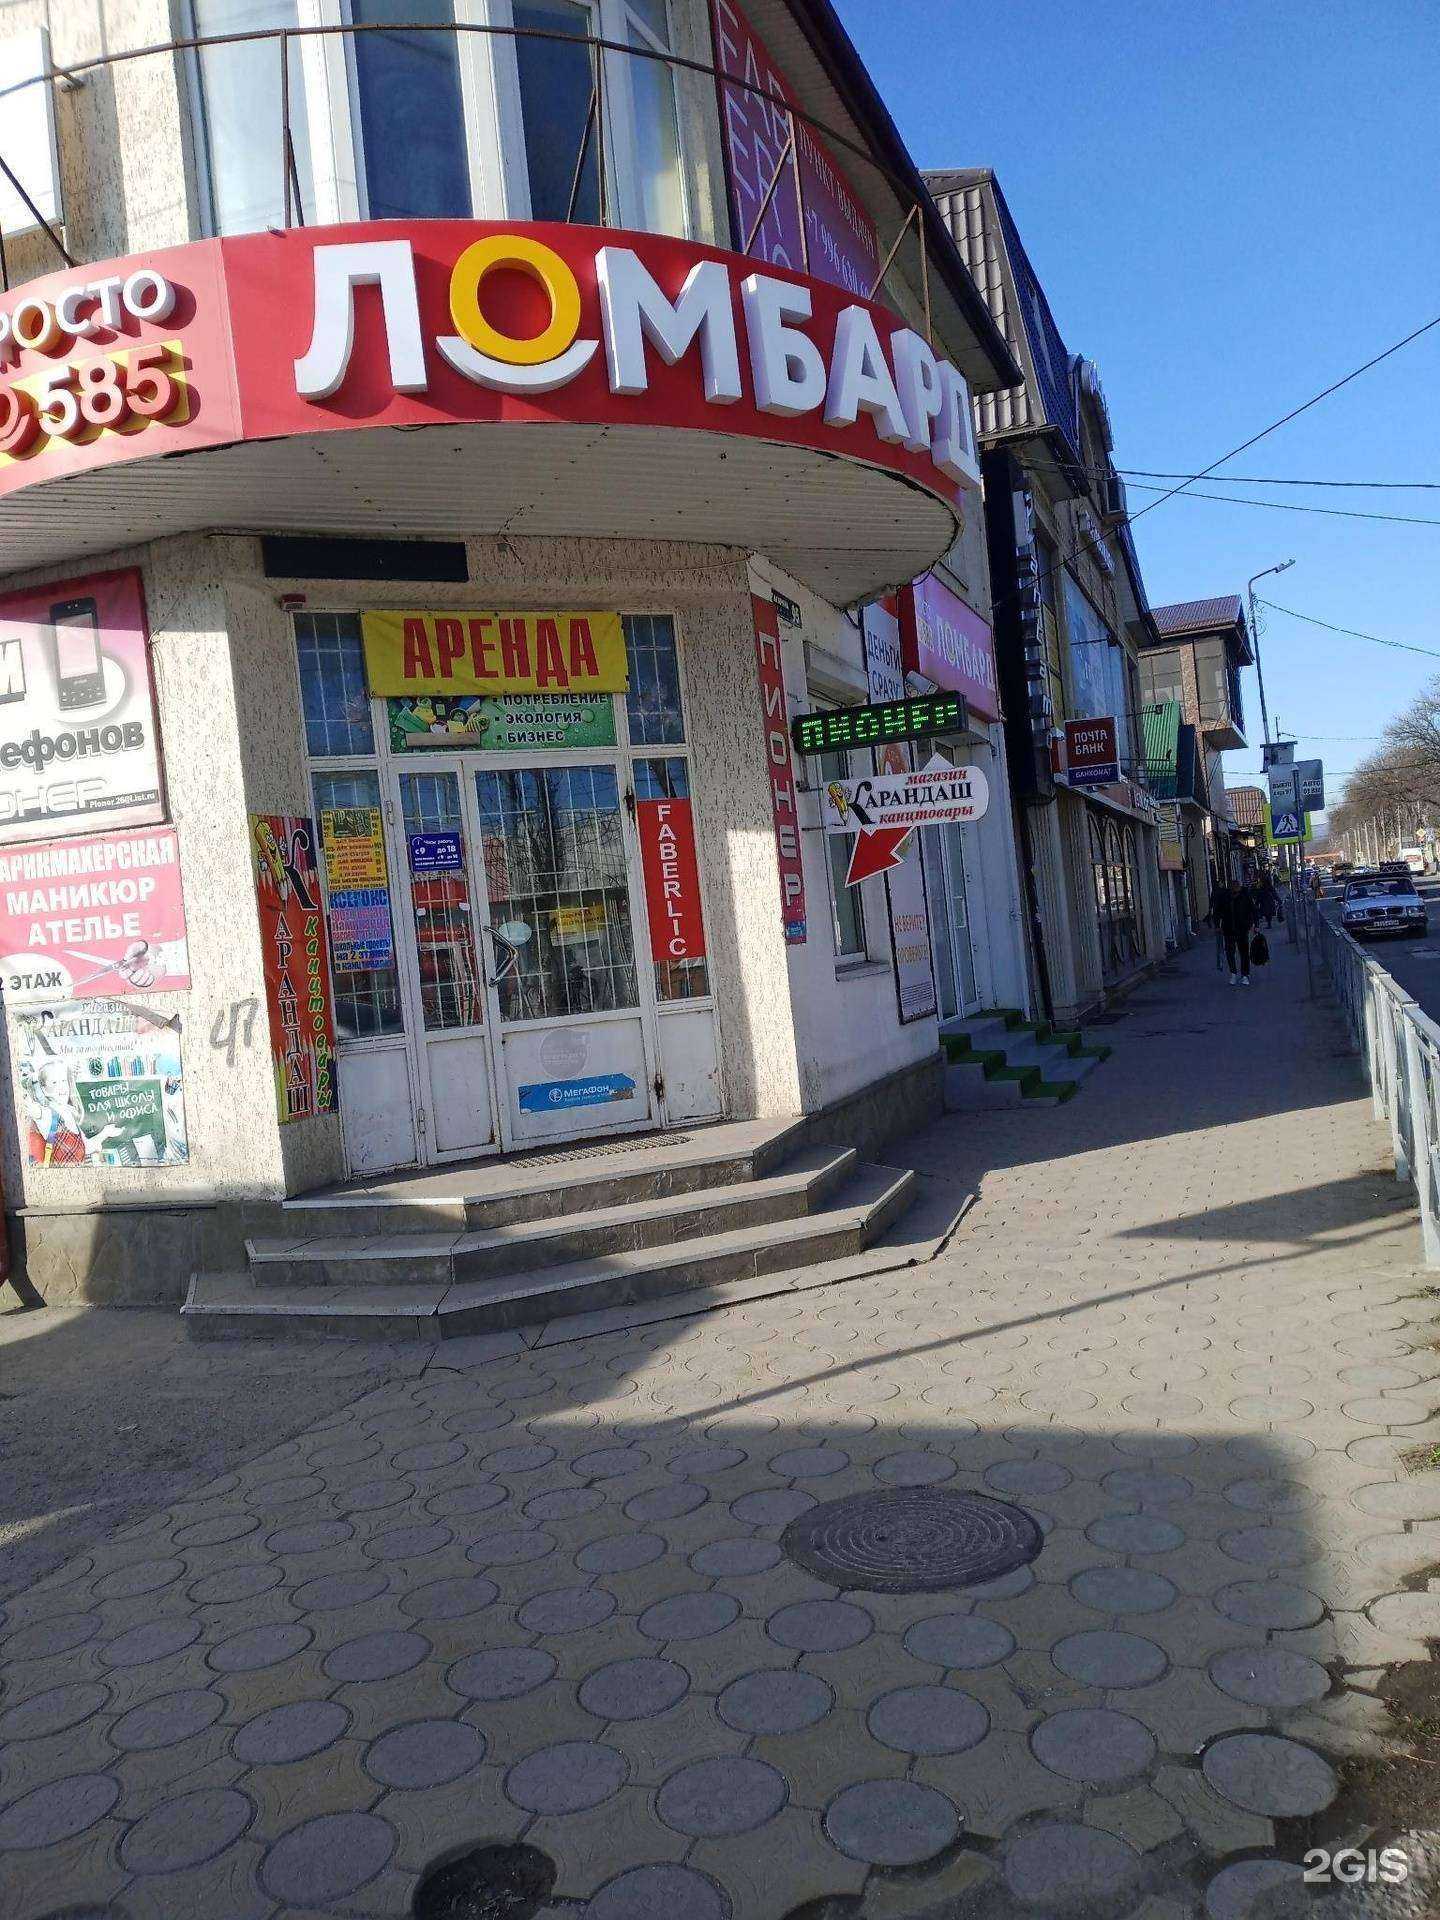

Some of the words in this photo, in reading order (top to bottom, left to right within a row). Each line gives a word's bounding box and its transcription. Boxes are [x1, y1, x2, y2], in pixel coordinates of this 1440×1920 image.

[293, 235, 981, 491] ЛОМБАРД
[38, 343, 176, 438] 585
[403, 617, 600, 688] АРЕНДА
[503, 692, 609, 706] ПОТРЕБЛЕНИЕ
[506, 713, 583, 724] ЭКОЛОГИЯ
[507, 730, 564, 743] БИЗНЕС
[1074, 729, 1108, 743] ПОЧТА
[1075, 743, 1105, 755] БАНК
[759, 631, 801, 907] ПИОНЕР
[905, 769, 968, 785] магазин
[1075, 768, 1112, 778] БАНКОМАТ
[849, 781, 973, 825] КАРАНДАШ
[879, 805, 975, 825] канцтовары
[657, 804, 687, 956] FABERLIC
[6, 876, 156, 916] МАНИКЮР
[28, 912, 142, 947] АТЕЛЬЕ
[9, 971, 63, 991] ЭТАЖ
[88, 1083, 131, 1100] ТОВАРЫ
[88, 1100, 114, 1113] ДЛЯ
[114, 1089, 156, 1110] ШКОЛЫ
[105, 1111, 117, 1123] И
